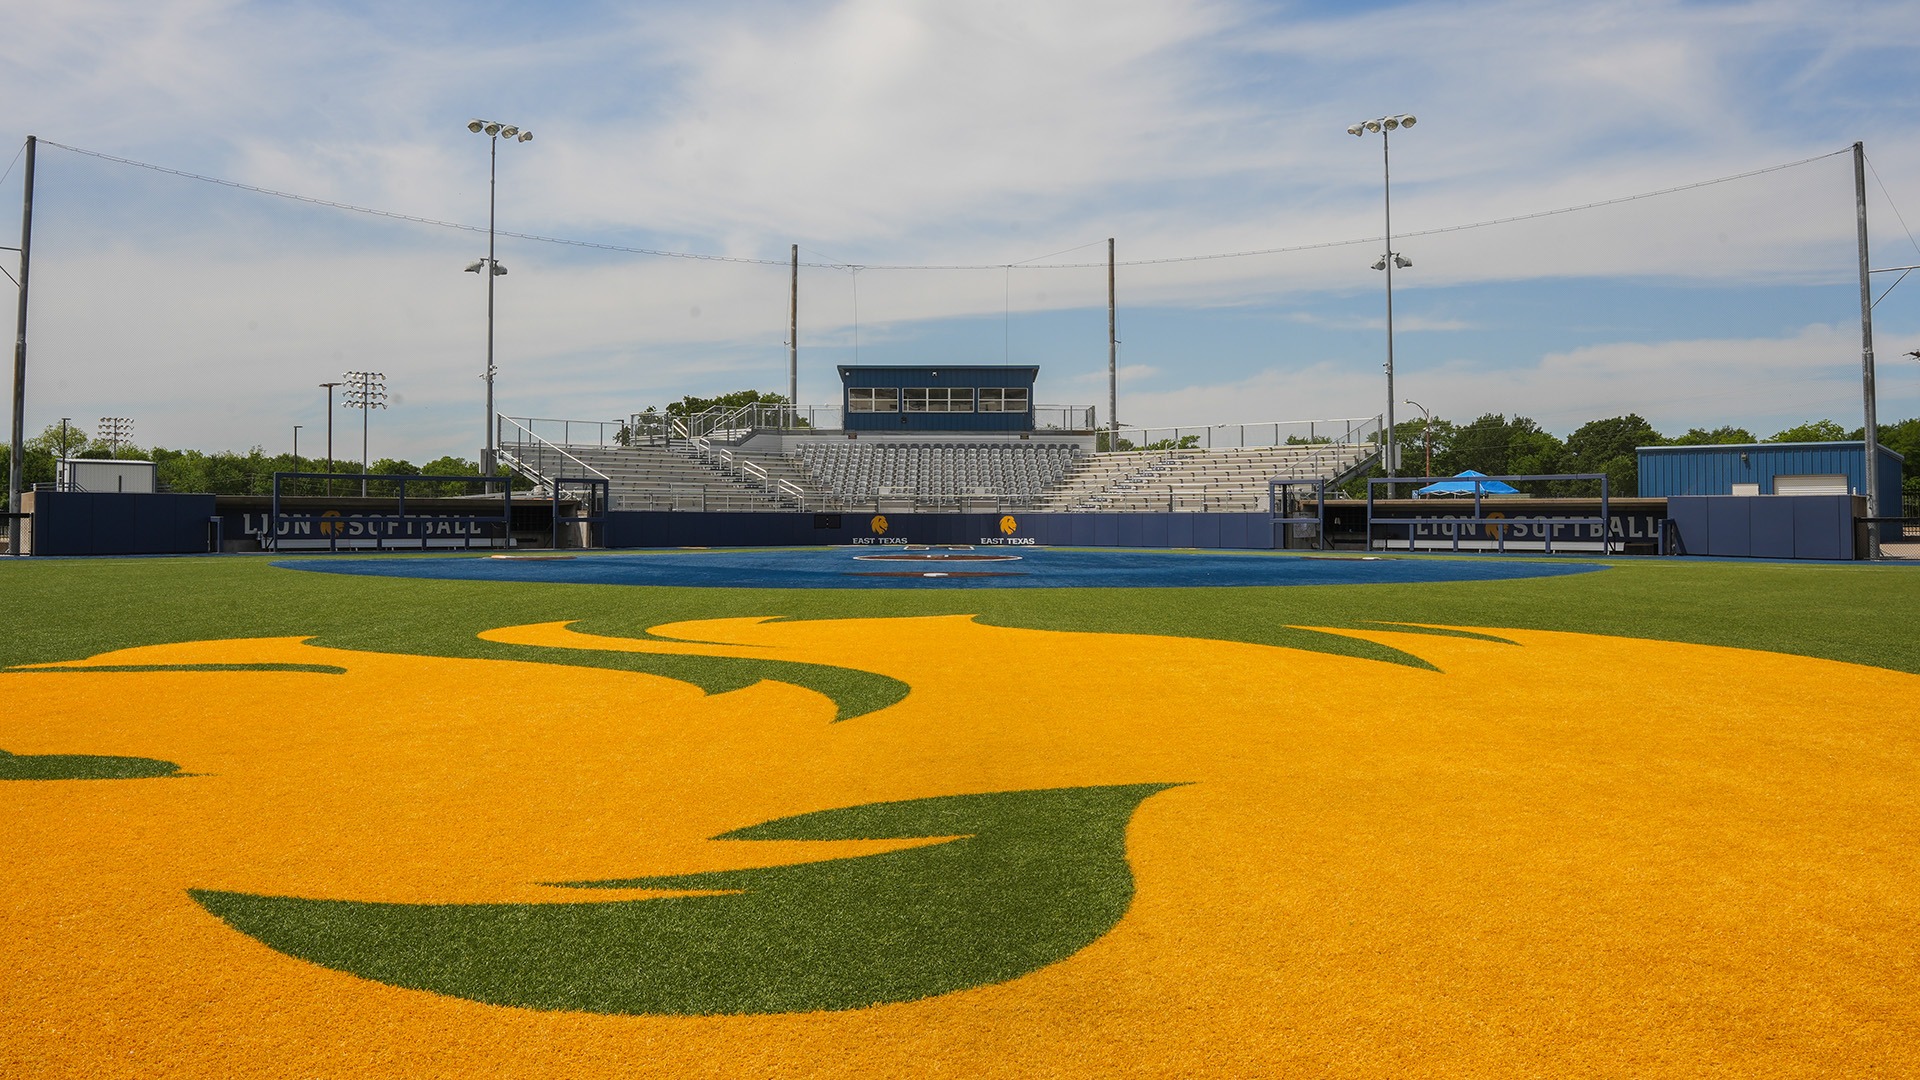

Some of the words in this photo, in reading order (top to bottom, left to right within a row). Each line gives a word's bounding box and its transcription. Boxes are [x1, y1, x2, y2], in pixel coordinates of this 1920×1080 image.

[243, 513, 311, 535] LION
[1416, 515, 1476, 536] LION
[853, 537, 876, 545] EAST
[878, 537, 908, 545] TEXAS
[981, 537, 1004, 545] EAST
[1007, 537, 1035, 545] TEXAS
